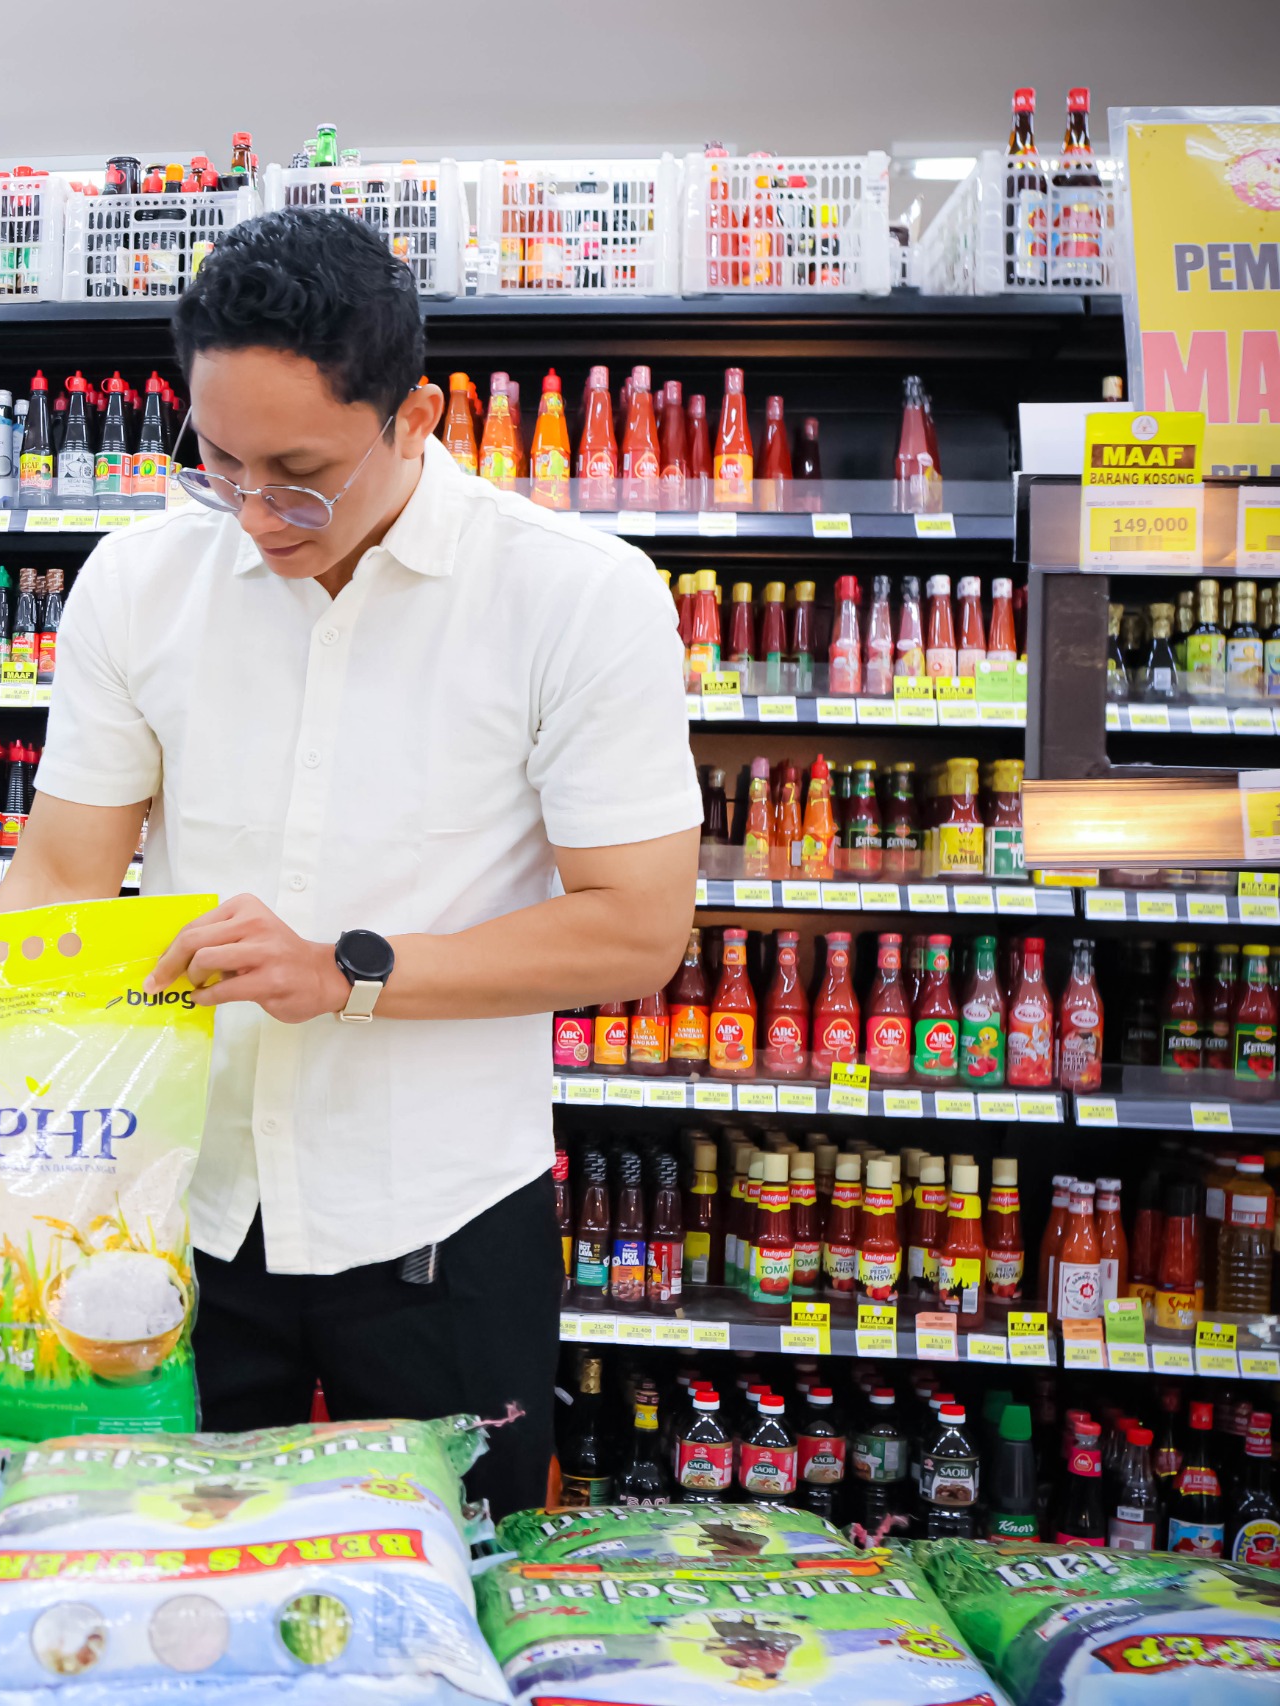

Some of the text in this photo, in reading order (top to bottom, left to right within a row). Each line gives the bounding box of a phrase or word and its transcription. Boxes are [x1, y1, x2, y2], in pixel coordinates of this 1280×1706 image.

[1102, 446, 1184, 466] MAAF
[1090, 473, 1194, 485] BARANG KOSONG
[1113, 517, 1189, 535] 149,000
[7, 671, 30, 679] MAAF
[31, 991, 87, 999] KOORDATOR
[126, 989, 196, 1010] bulog
[560, 1030, 580, 1039] ABC
[609, 1029, 627, 1038] ABC
[718, 1025, 741, 1035] ABC
[772, 1027, 797, 1037] ABC
[828, 1029, 853, 1040] ABC
[880, 1028, 904, 1039] ABC
[930, 1031, 953, 1042] ABC
[763, 1249, 791, 1259] Indofood
[865, 1253, 895, 1263] Indofood
[761, 1265, 791, 1274] TOMAT
[863, 1273, 896, 1281] DAHSYAT
[798, 1313, 823, 1321] MAAF
[864, 1316, 890, 1324] MAAF
[1014, 1323, 1040, 1331] MAAF
[1202, 1332, 1230, 1341] MAAF
[23, 1434, 410, 1476] Putri Sejati
[689, 1461, 711, 1470] SAORI
[754, 1465, 777, 1474] SAORI
[940, 1467, 969, 1477] SAORI
[998, 1519, 1034, 1533] Knorr
[209, 1532, 416, 1570] BERAS
[508, 1577, 923, 1611] Putri Sejati
